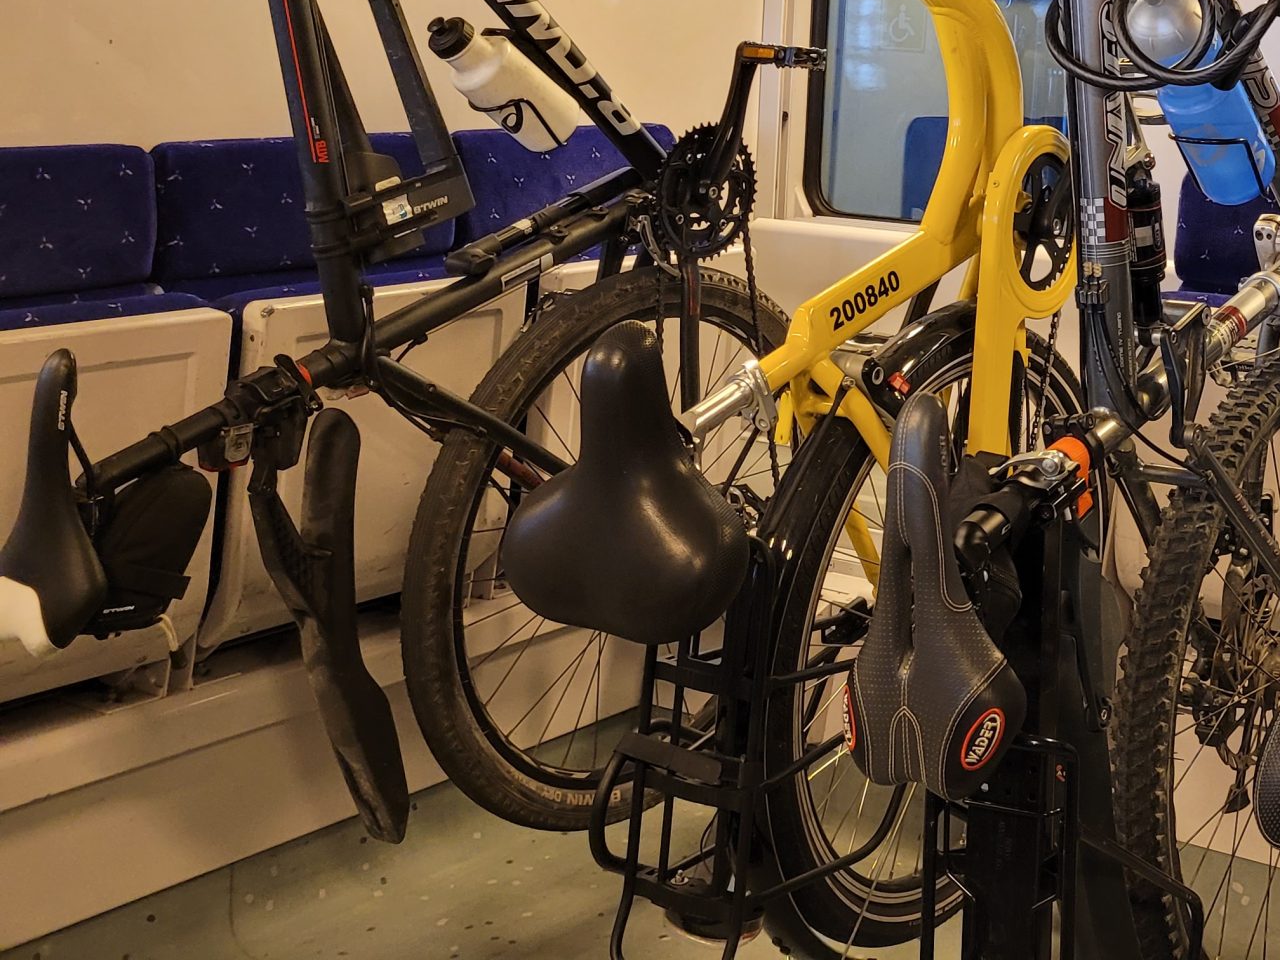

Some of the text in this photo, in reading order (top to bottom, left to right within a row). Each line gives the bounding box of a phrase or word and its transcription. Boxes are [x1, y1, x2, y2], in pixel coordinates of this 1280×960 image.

[315, 140, 330, 164] MTB
[829, 270, 900, 331] 200840
[965, 719, 998, 764] WADER
